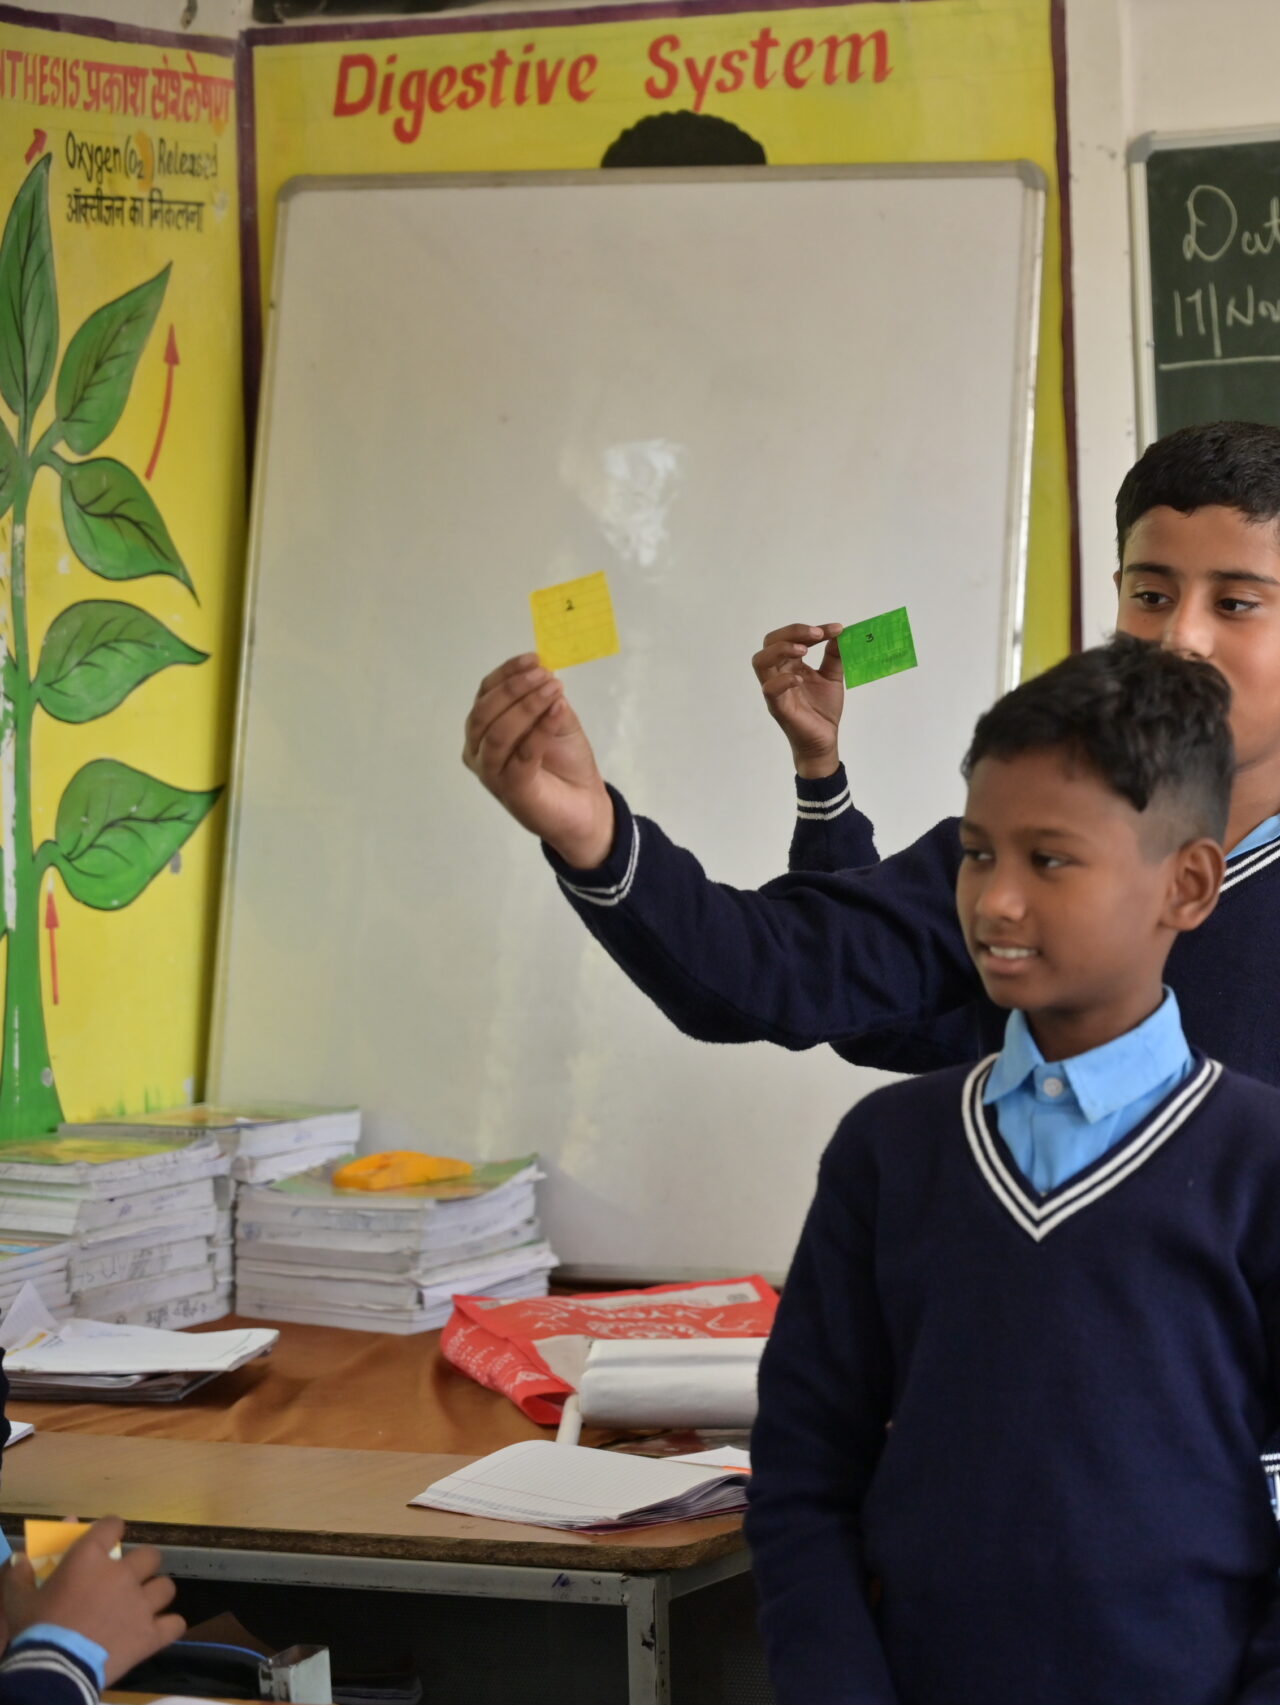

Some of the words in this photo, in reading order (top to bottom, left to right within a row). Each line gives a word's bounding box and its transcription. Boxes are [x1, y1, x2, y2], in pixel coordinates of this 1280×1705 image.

[0, 50, 81, 109] THESIS
[83, 60, 150, 117] प्रकाश
[333, 43, 598, 144] Digestive
[645, 27, 894, 112] System
[65, 130, 124, 185] Oxygen
